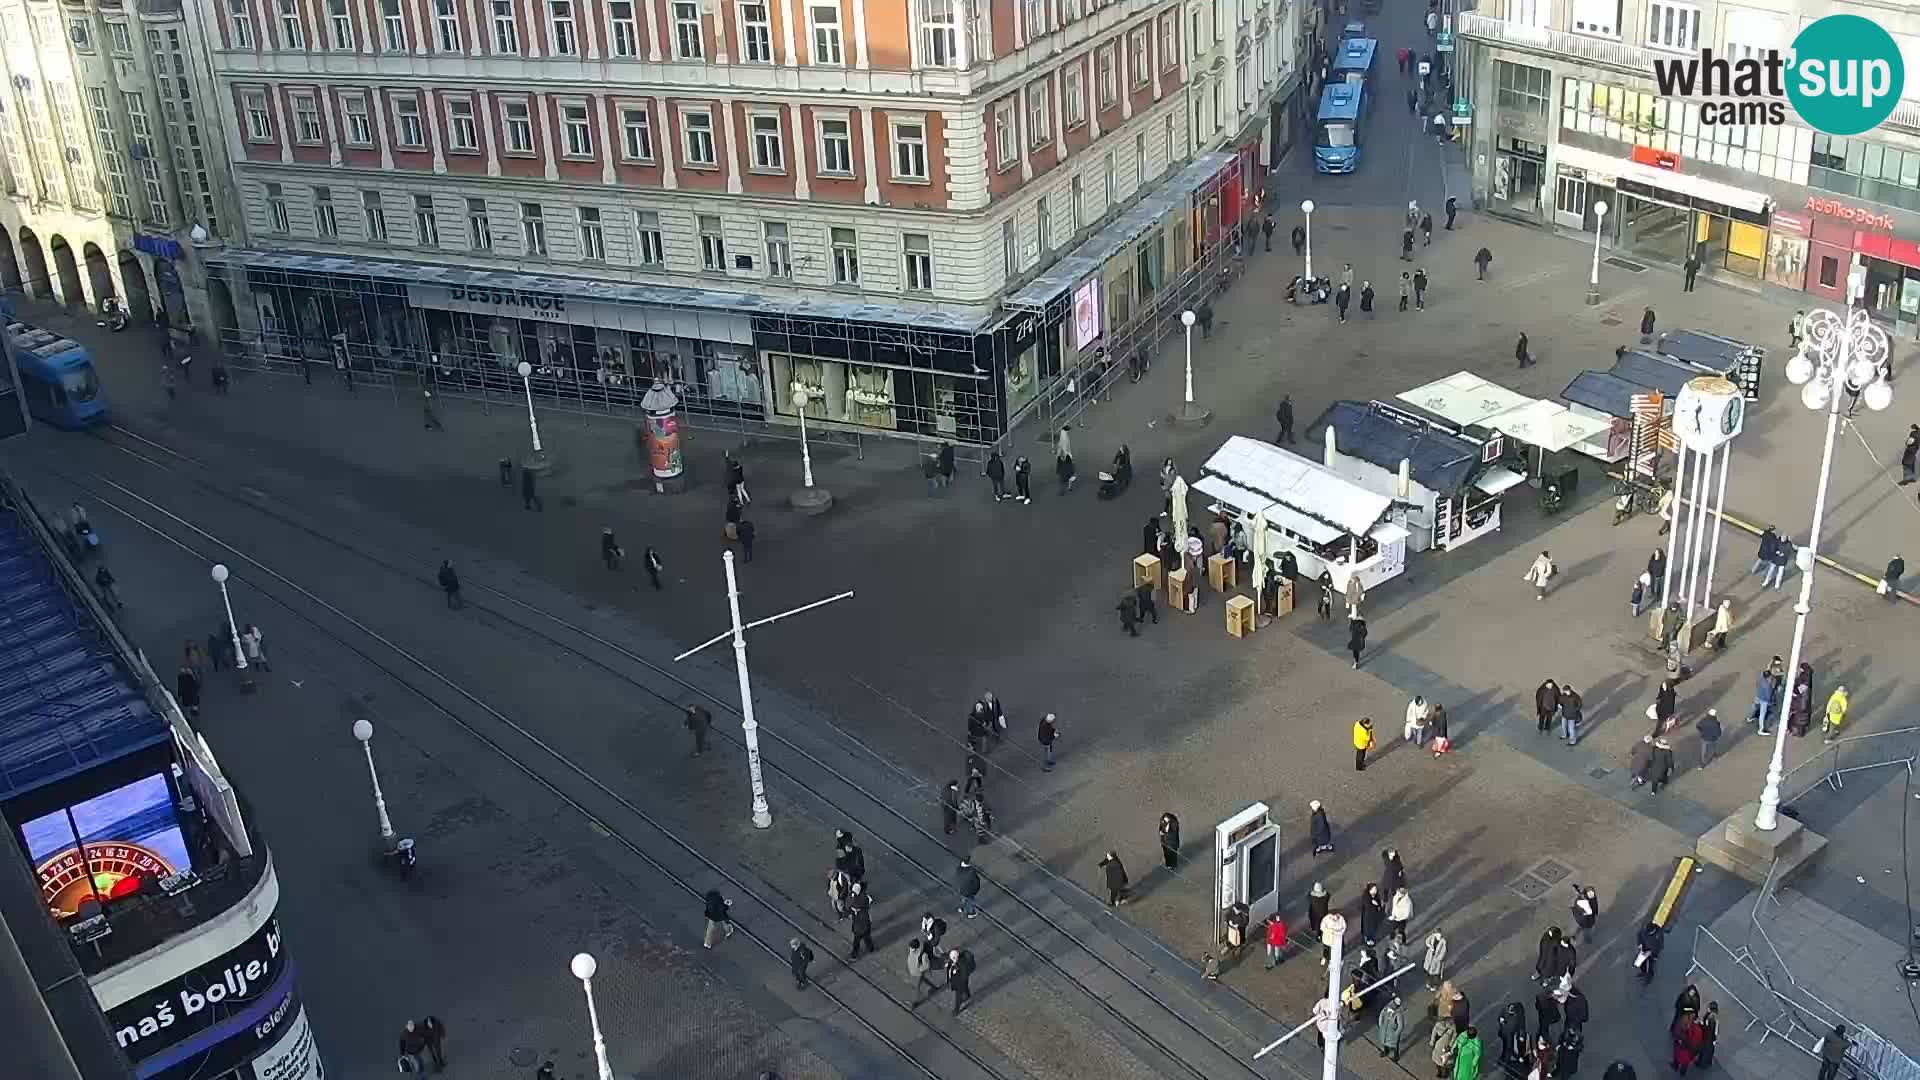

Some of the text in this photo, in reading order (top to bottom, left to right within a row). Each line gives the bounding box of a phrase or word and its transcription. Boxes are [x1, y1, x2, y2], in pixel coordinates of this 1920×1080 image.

[1855, 208, 1895, 230] Bank
[116, 1000, 175, 1048] naš
[180, 960, 268, 1016] bolje,
